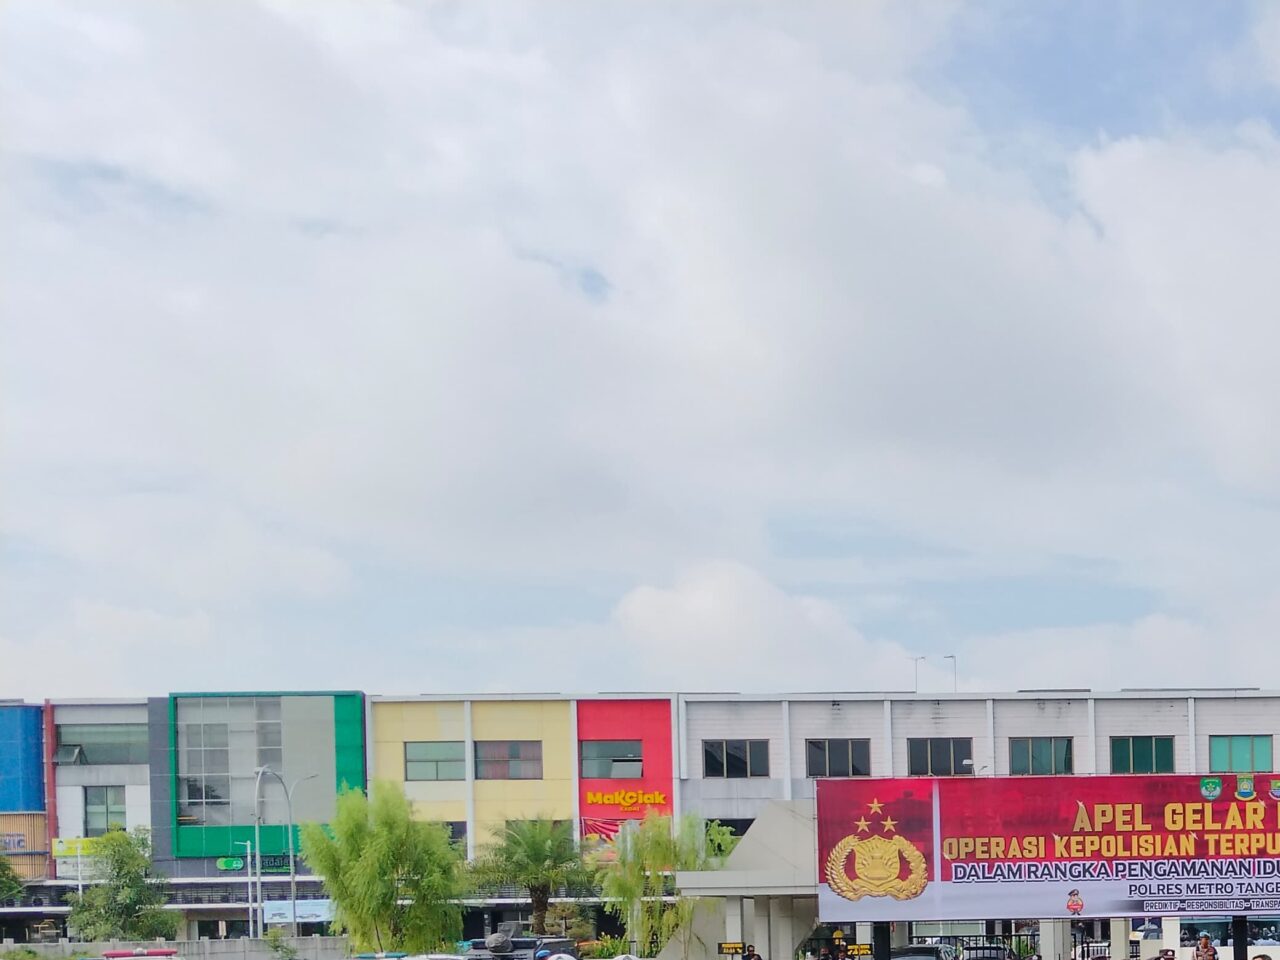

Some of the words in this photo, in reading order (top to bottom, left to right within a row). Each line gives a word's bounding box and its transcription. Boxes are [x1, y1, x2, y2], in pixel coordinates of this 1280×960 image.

[587, 789, 666, 807] MakCiak
[1072, 803, 1152, 832] APEL
[1164, 801, 1265, 831] GELAR
[943, 836, 1046, 859] OPERASI
[1055, 834, 1196, 858] KEPOLISIAN
[953, 863, 1025, 881] DALAM
[1028, 861, 1111, 880] RANGKA
[1115, 859, 1250, 878] PENGAMANAN
[1128, 884, 1183, 895] POLRES
[1185, 883, 1233, 895] METRO
[1144, 902, 1179, 910] PREDIKTIF
[1186, 900, 1244, 910] RESPONSIBILITAS
